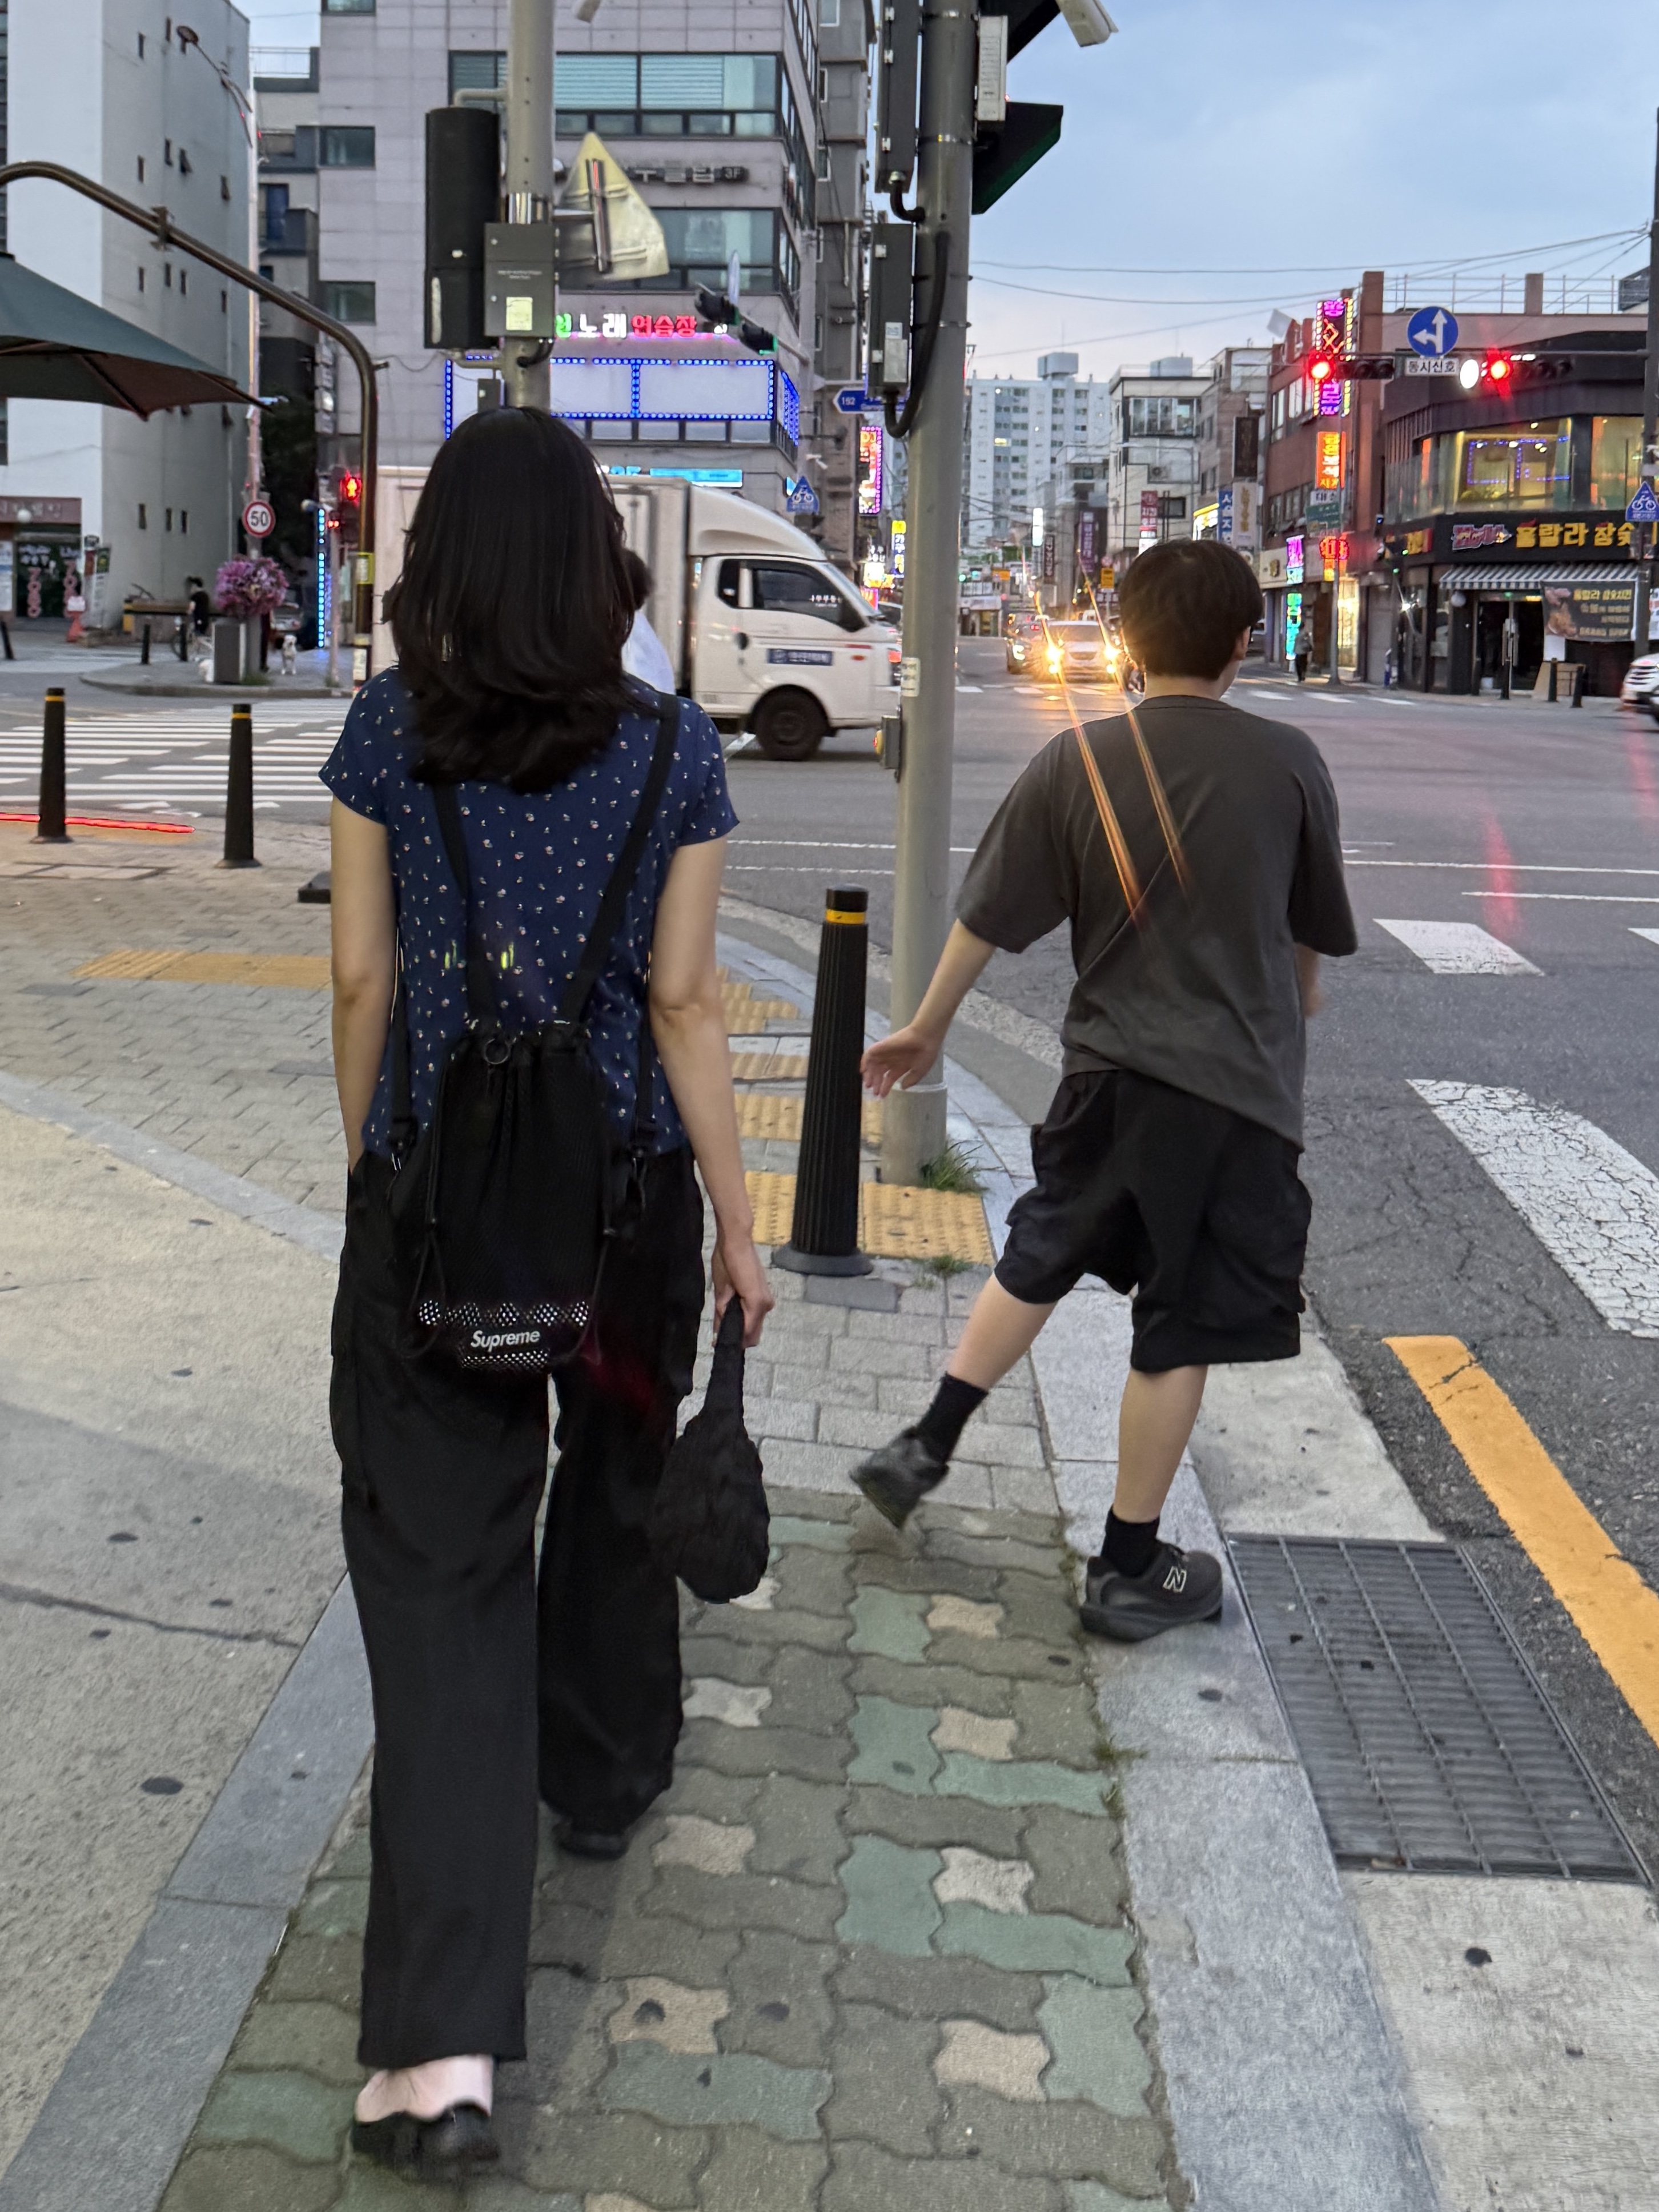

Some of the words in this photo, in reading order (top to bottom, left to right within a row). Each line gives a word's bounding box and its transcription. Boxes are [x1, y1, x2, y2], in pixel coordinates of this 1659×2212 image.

[631, 314, 697, 338] 연습장
[1408, 360, 1455, 373] 동시신호
[251, 511, 268, 527] 50
[470, 1330, 541, 1352] Supreme
[1163, 1565, 1187, 1593] N
